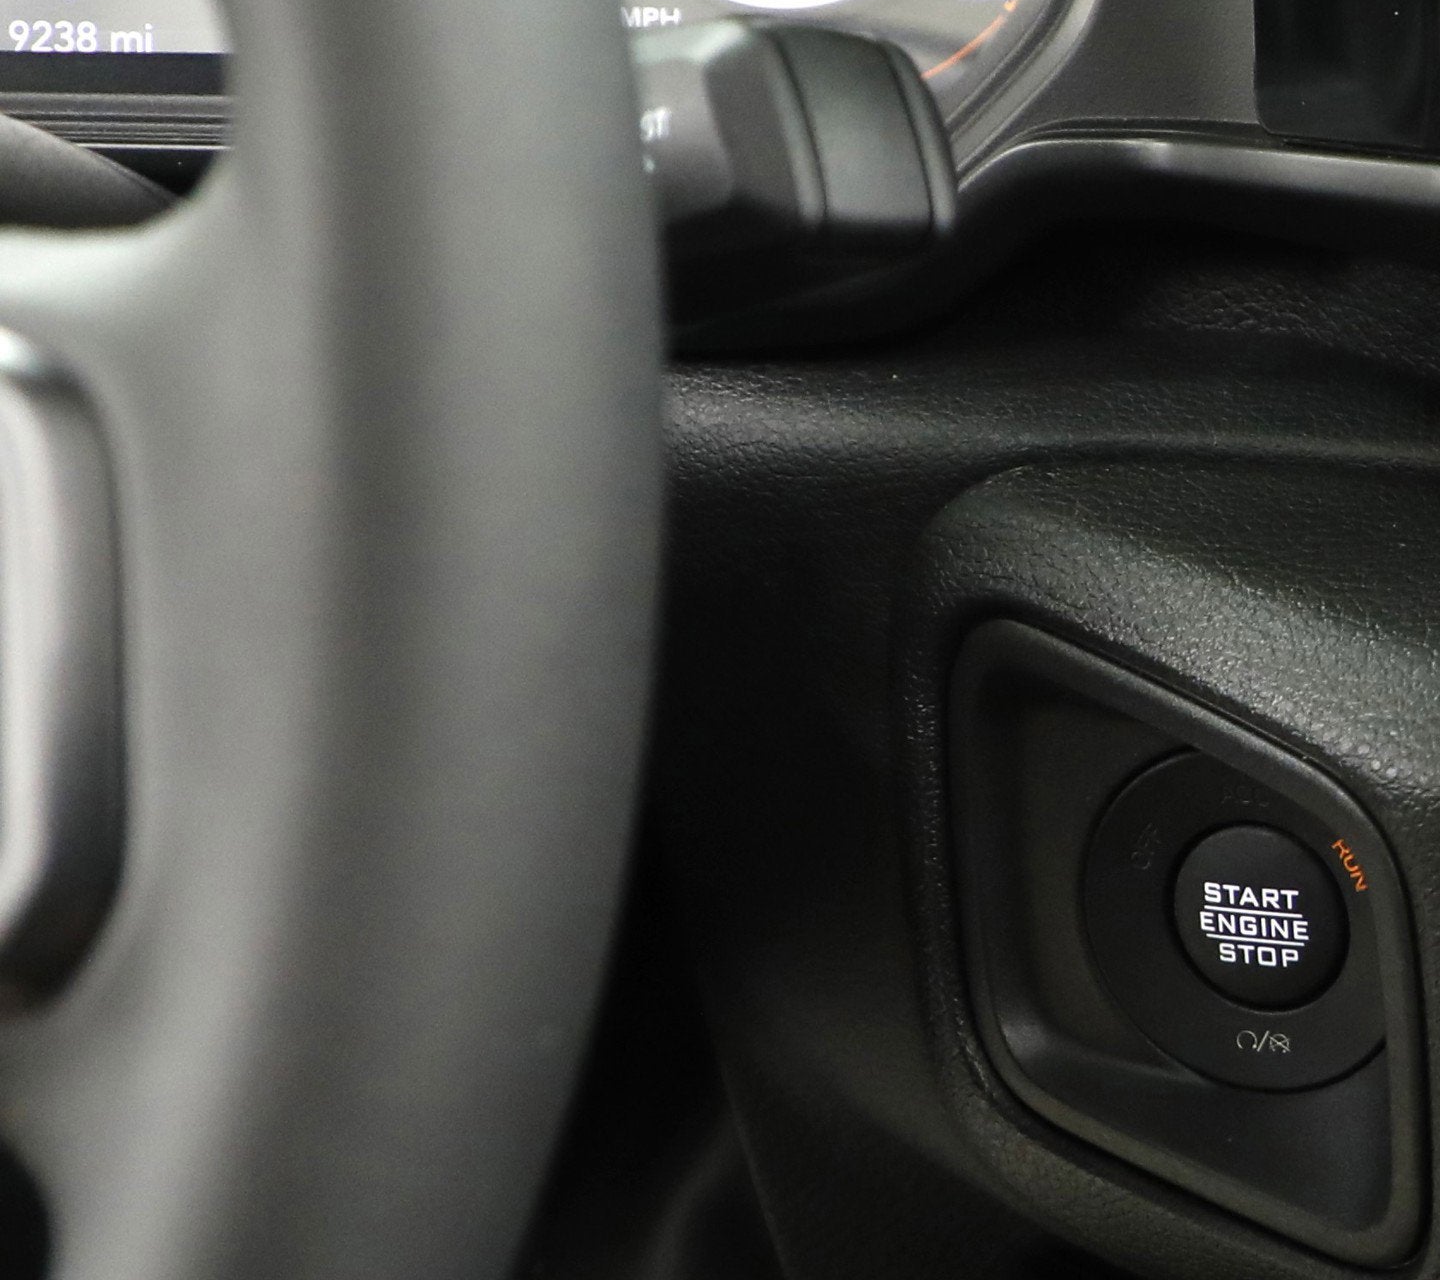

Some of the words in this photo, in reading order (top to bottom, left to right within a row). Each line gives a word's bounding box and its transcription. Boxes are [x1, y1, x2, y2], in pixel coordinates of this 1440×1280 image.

[621, 6, 681, 27] MPH
[8, 20, 97, 52] 9238
[110, 24, 154, 52] mi
[1332, 838, 1367, 892] RUN
[1204, 881, 1299, 910] START
[1200, 911, 1310, 941] ENGINE
[1219, 942, 1299, 968] STOP
